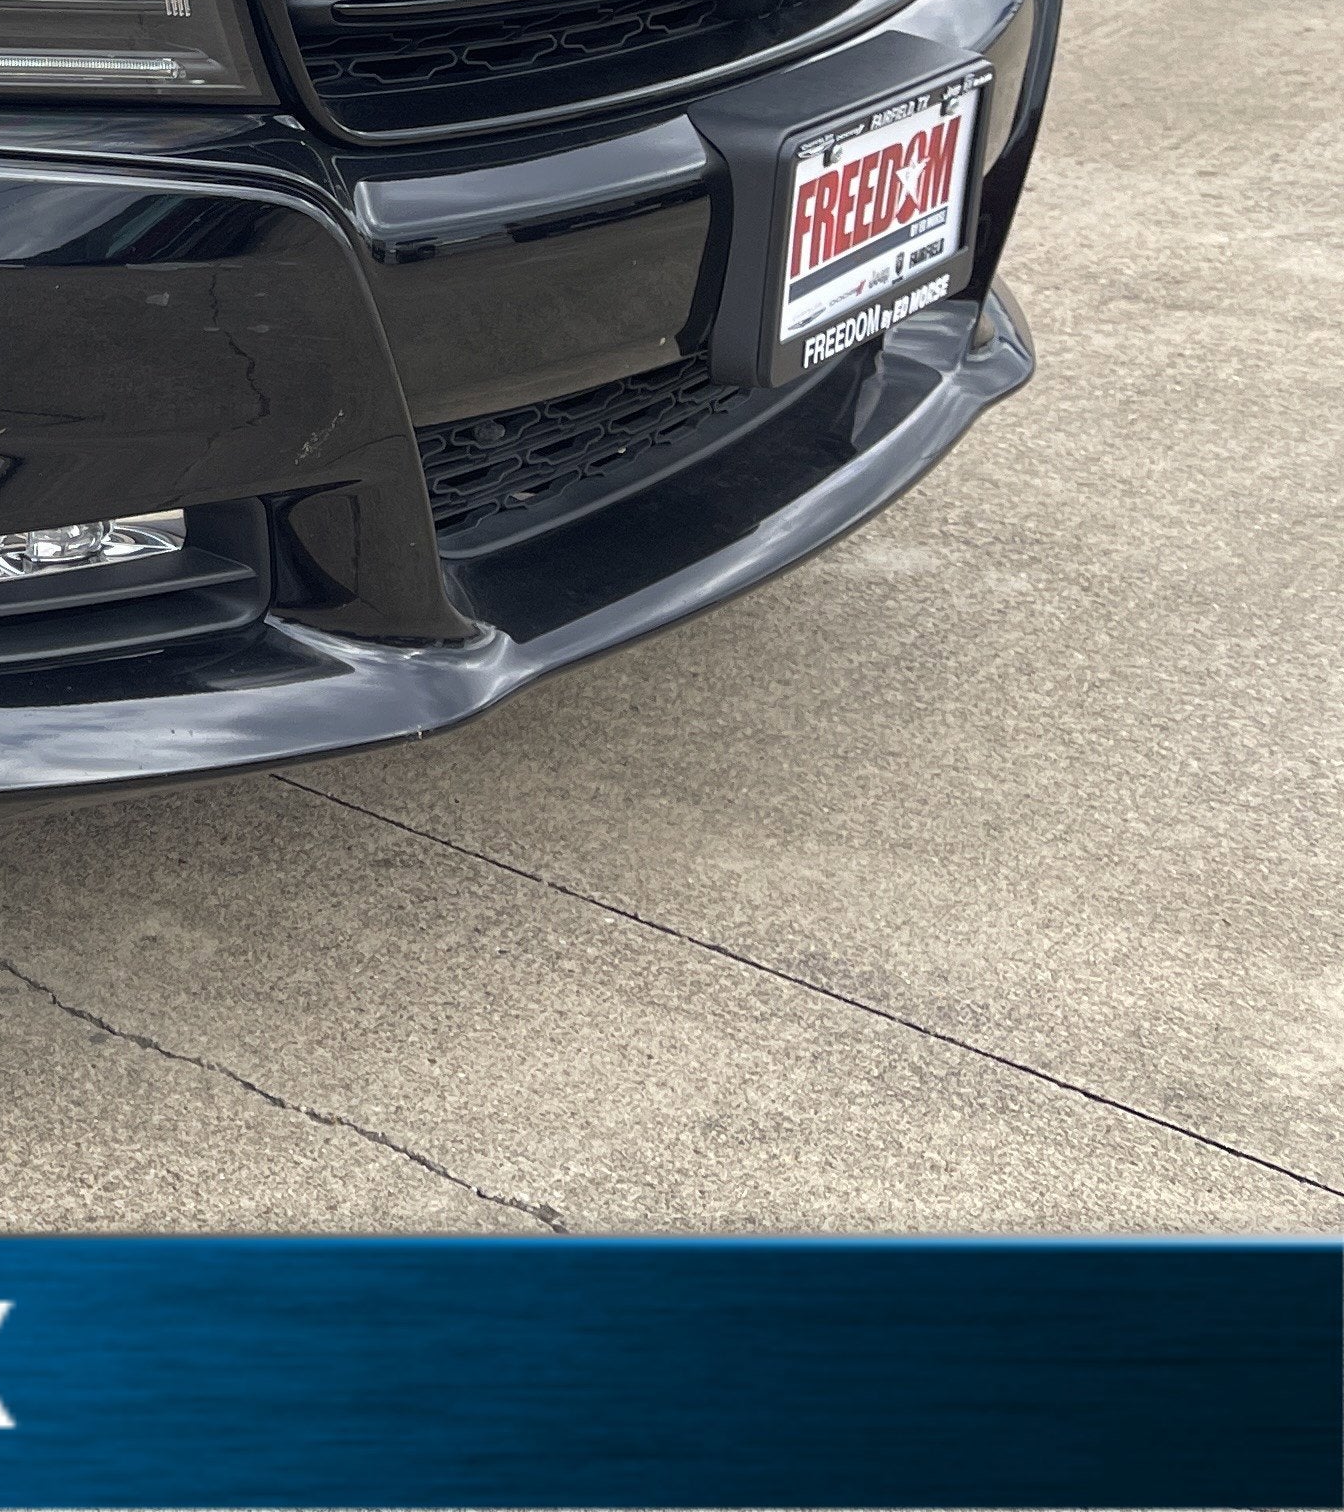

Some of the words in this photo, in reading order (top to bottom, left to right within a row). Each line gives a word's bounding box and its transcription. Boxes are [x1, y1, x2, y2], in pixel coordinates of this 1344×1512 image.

[790, 115, 962, 280] FREEDOM
[802, 303, 881, 369] FREEDOM
[892, 295, 910, 324] ED
[908, 273, 951, 315] MORSE
